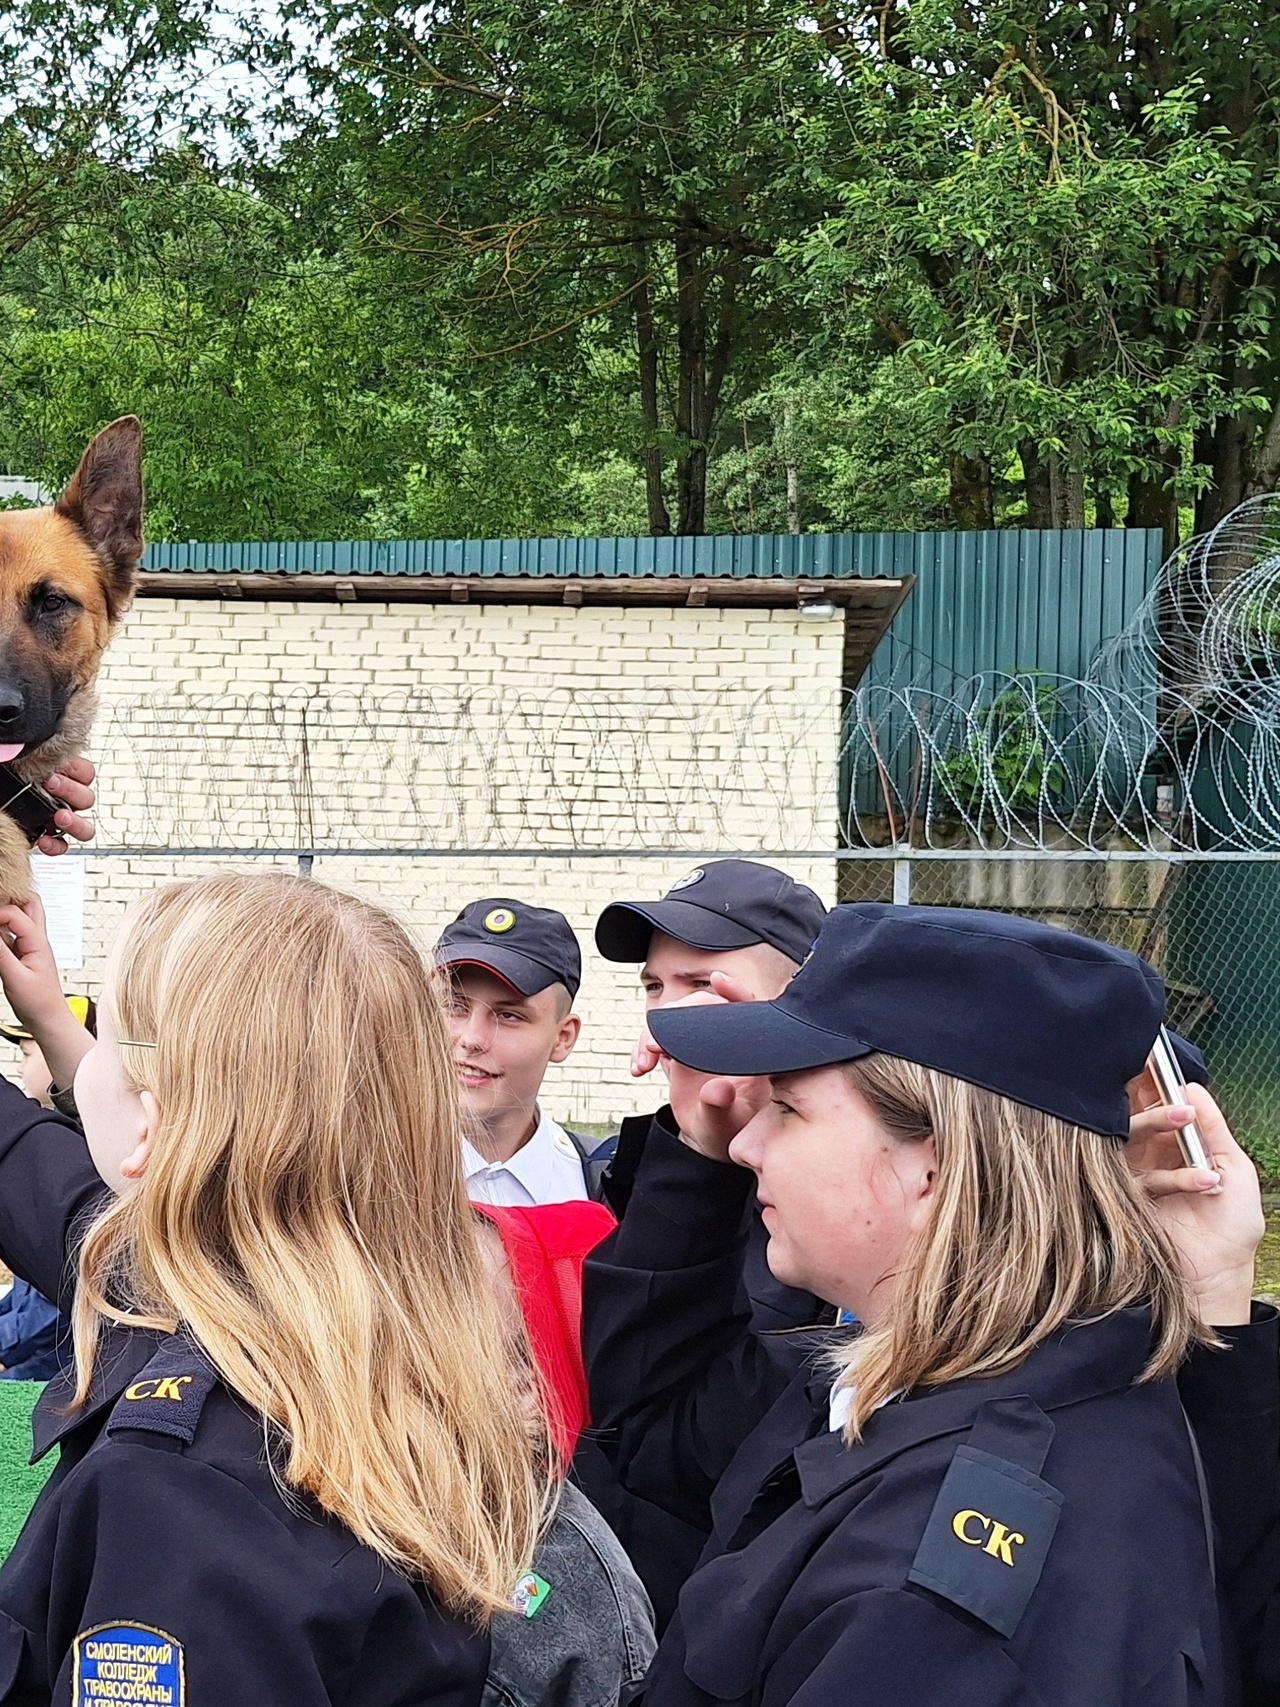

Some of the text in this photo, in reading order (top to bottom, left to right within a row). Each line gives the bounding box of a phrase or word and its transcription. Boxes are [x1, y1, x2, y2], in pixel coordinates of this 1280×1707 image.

[125, 1376, 192, 1401] СК
[952, 1509, 1025, 1567] СК
[85, 1641, 173, 1665] СМОЛЕНСКИЙ
[97, 1661, 158, 1684] КОЛЛЕДЖ
[83, 1678, 173, 1703] ПРАВООХРАНЫ
